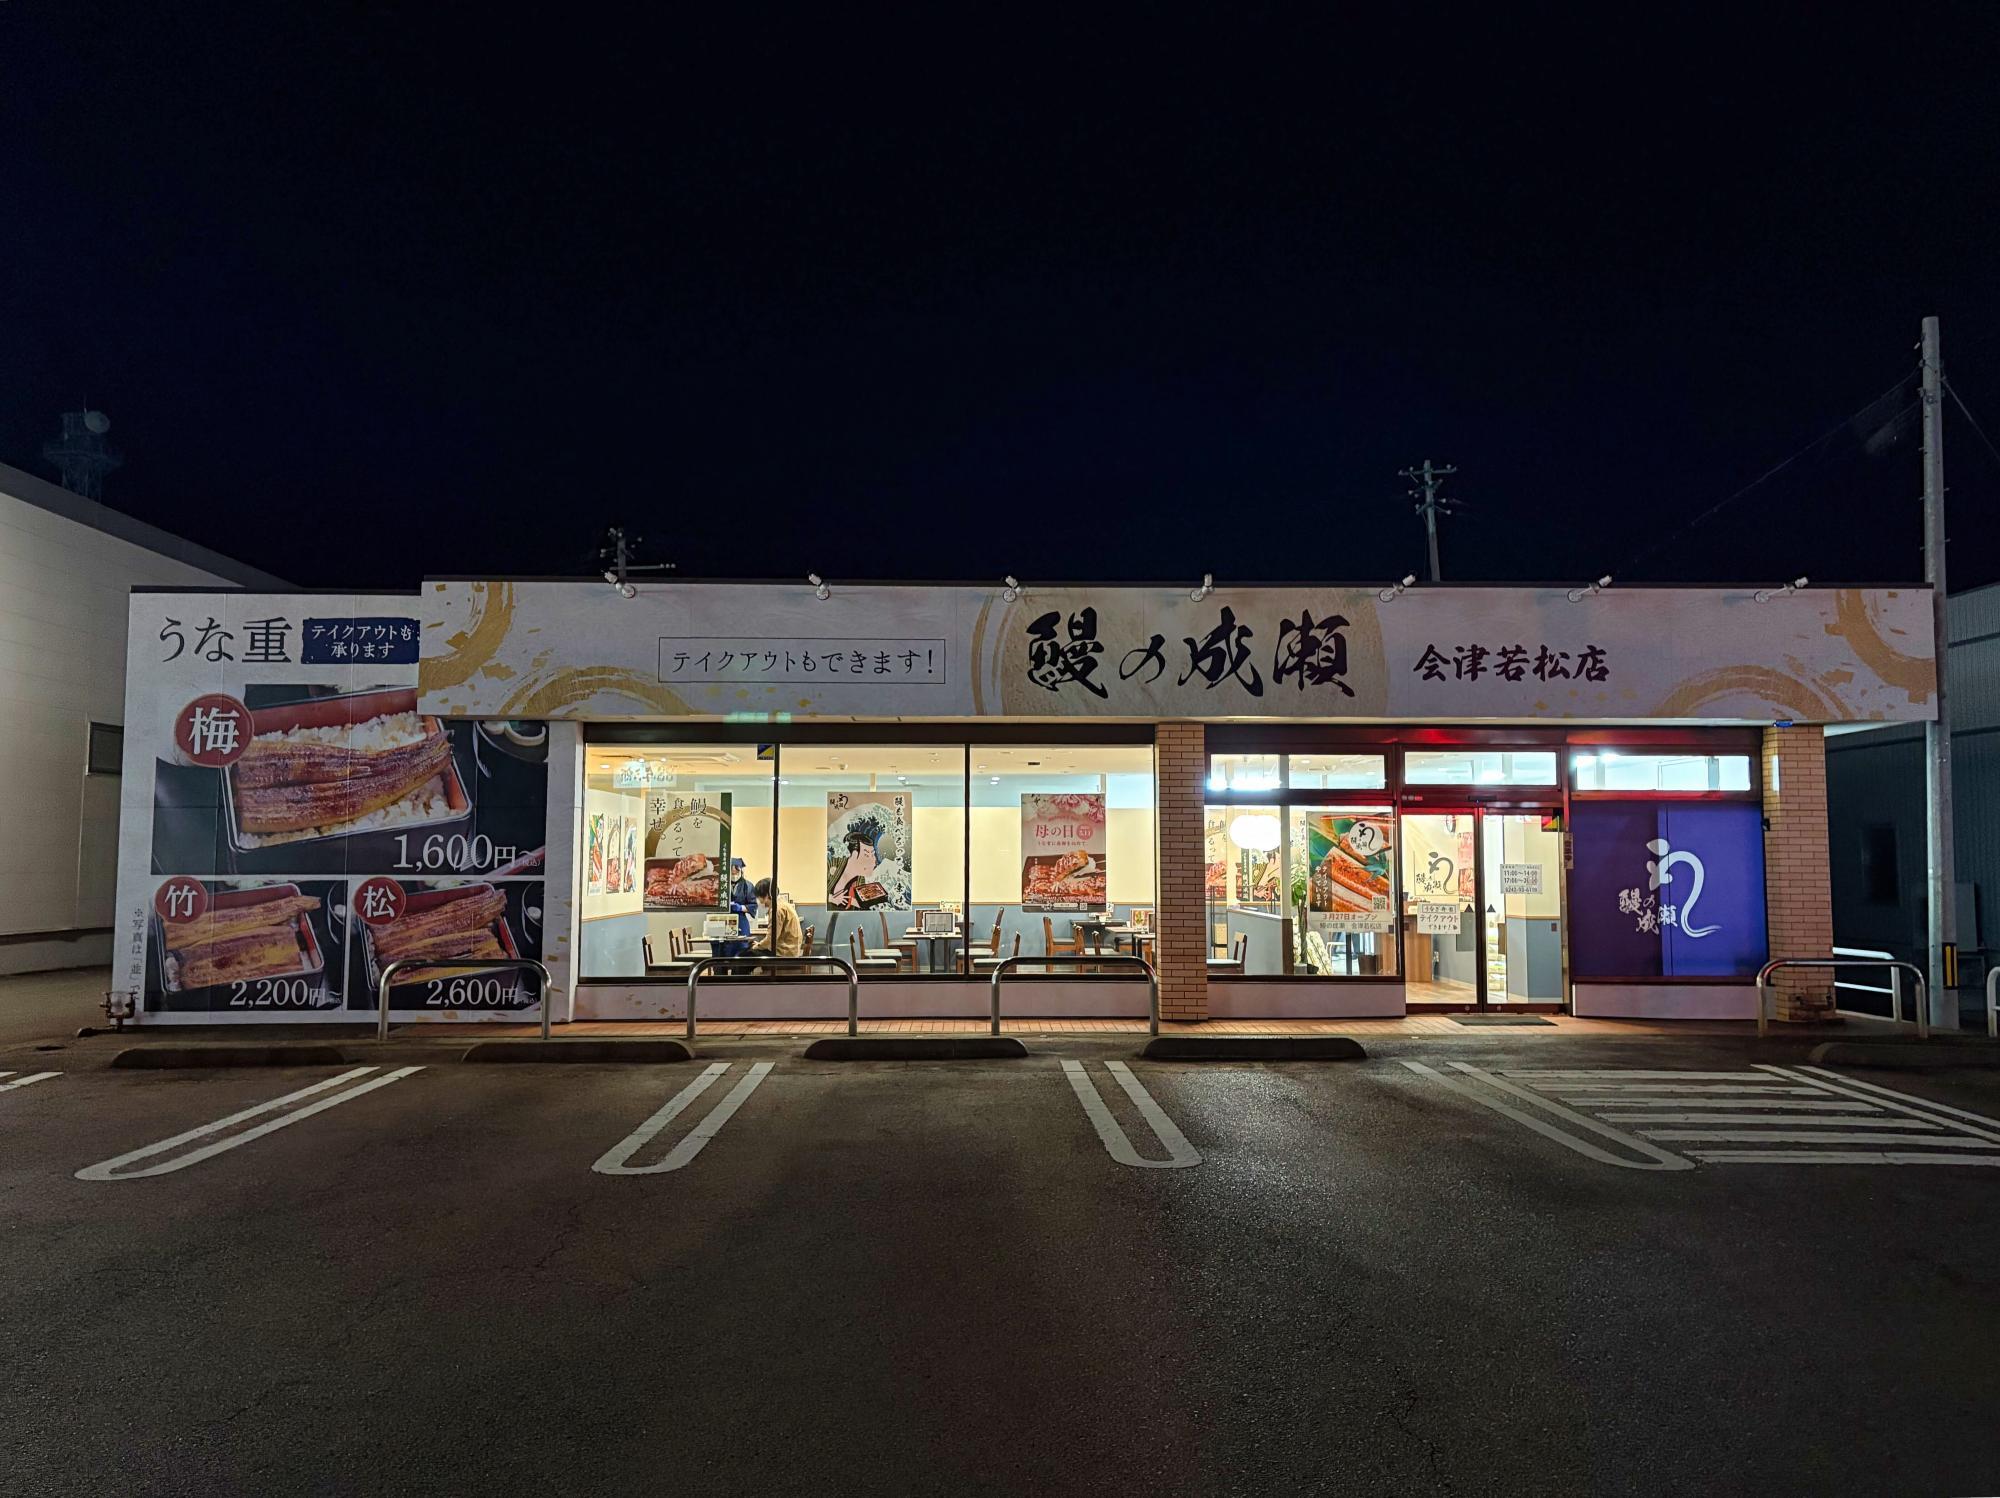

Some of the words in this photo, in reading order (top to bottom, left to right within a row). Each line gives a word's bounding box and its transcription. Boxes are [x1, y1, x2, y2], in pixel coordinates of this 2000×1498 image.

[158, 616, 293, 664] うな重
[311, 625, 412, 641] テイクアウトも
[331, 642, 395, 658] 承ります
[1026, 605, 1355, 699] 鰻の成瀬
[1413, 644, 1611, 684] 会津若松店
[188, 706, 240, 756] 梅
[1035, 824, 1074, 838] 母の日
[164, 885, 198, 918] 竹
[362, 885, 397, 918] 松
[1618, 888, 1678, 935] 鰻の成瀬
[1419, 914, 1459, 923] テイクアウト
